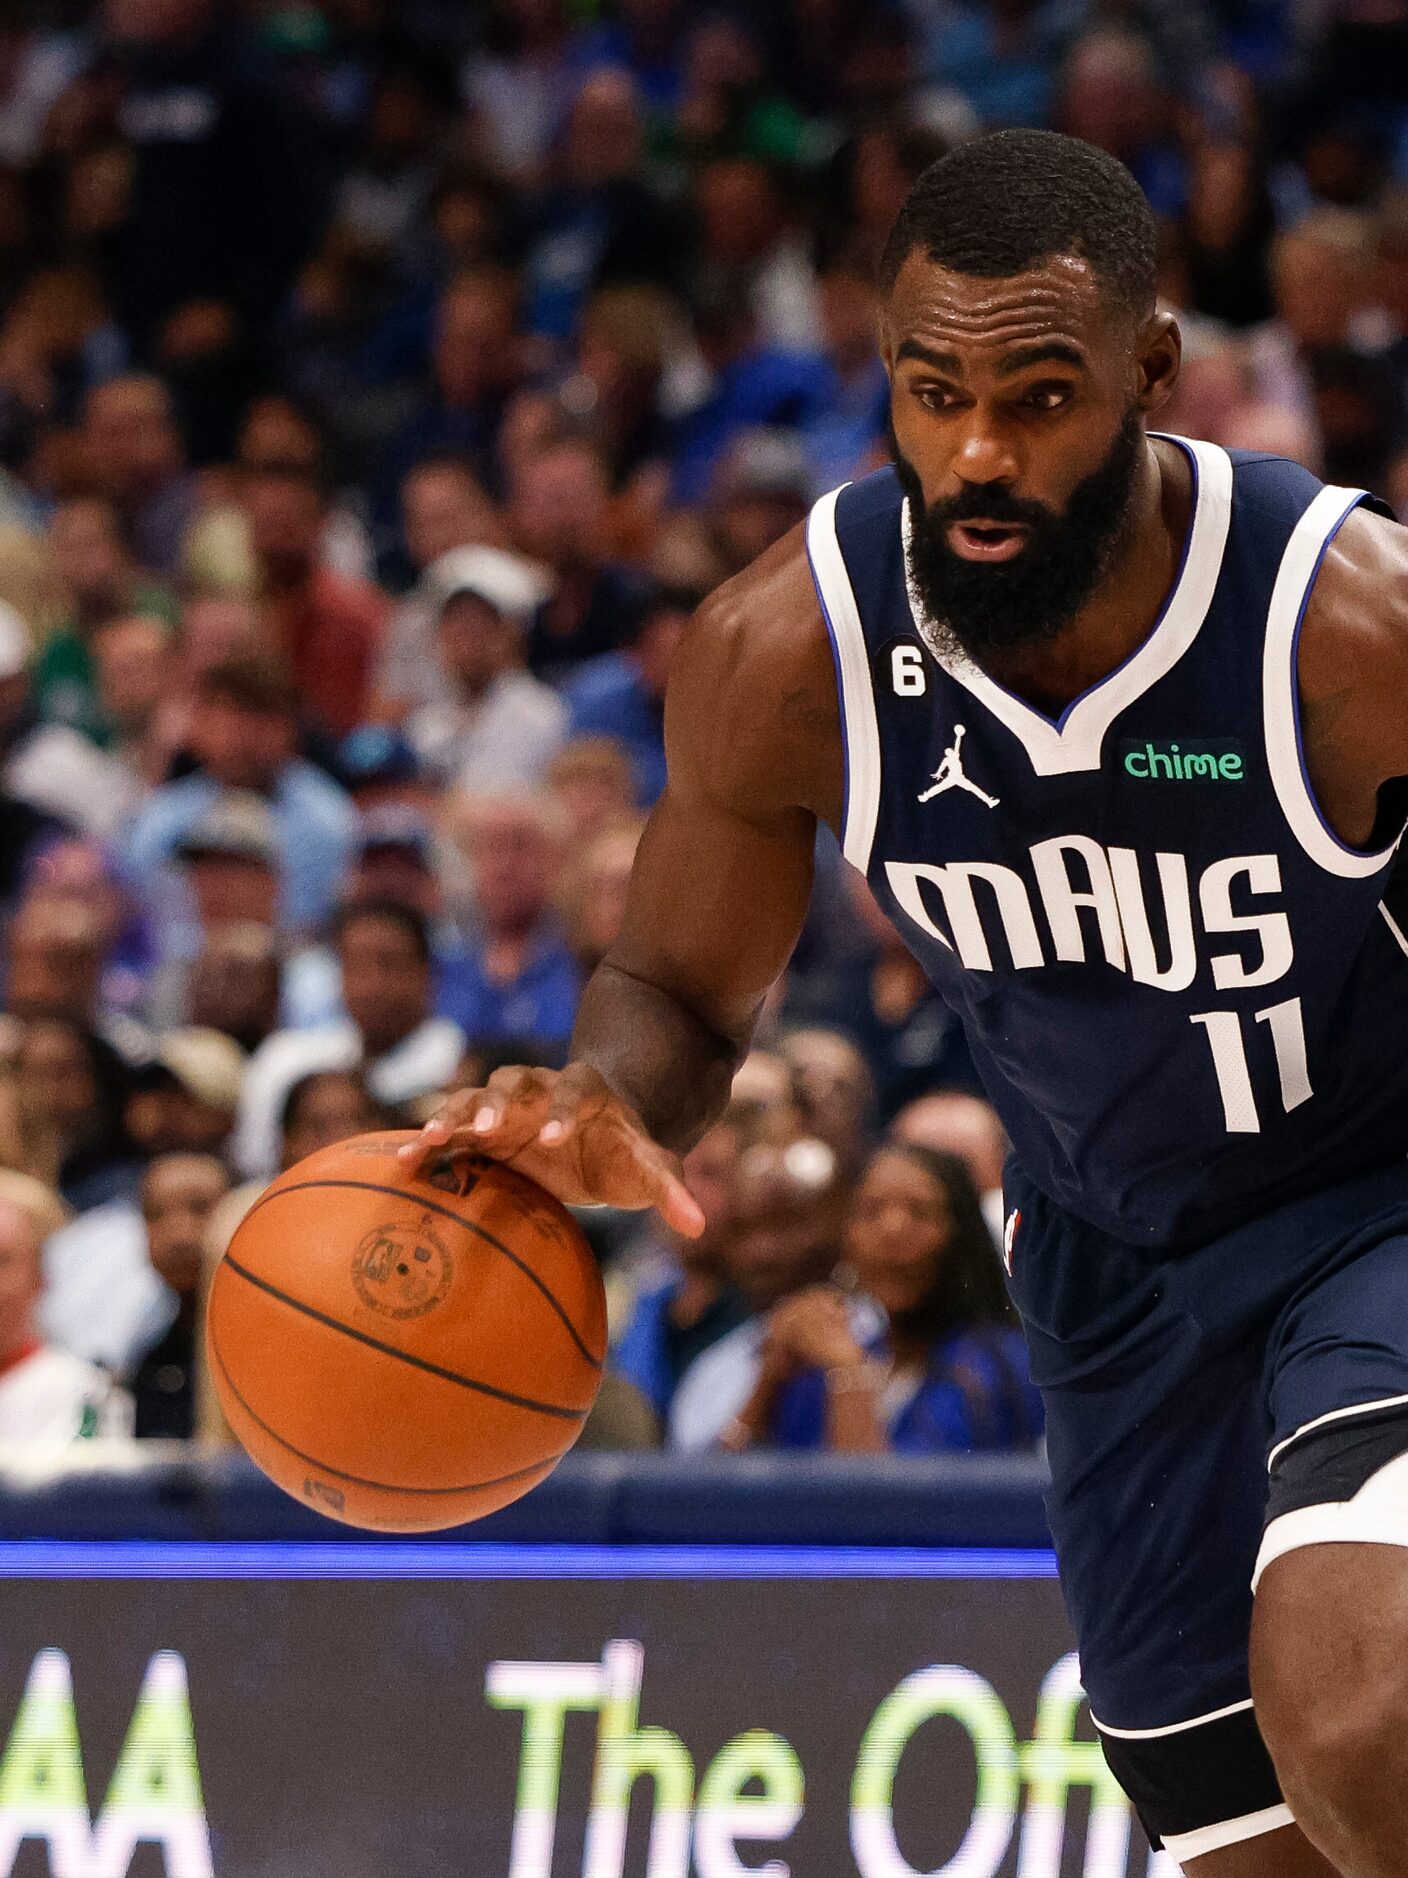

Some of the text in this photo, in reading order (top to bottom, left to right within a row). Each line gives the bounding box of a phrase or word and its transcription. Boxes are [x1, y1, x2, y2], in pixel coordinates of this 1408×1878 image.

[892, 645, 926, 697] 6
[1124, 743, 1244, 780] chime
[1189, 996, 1314, 1134] 11
[484, 1638, 806, 1878] The
